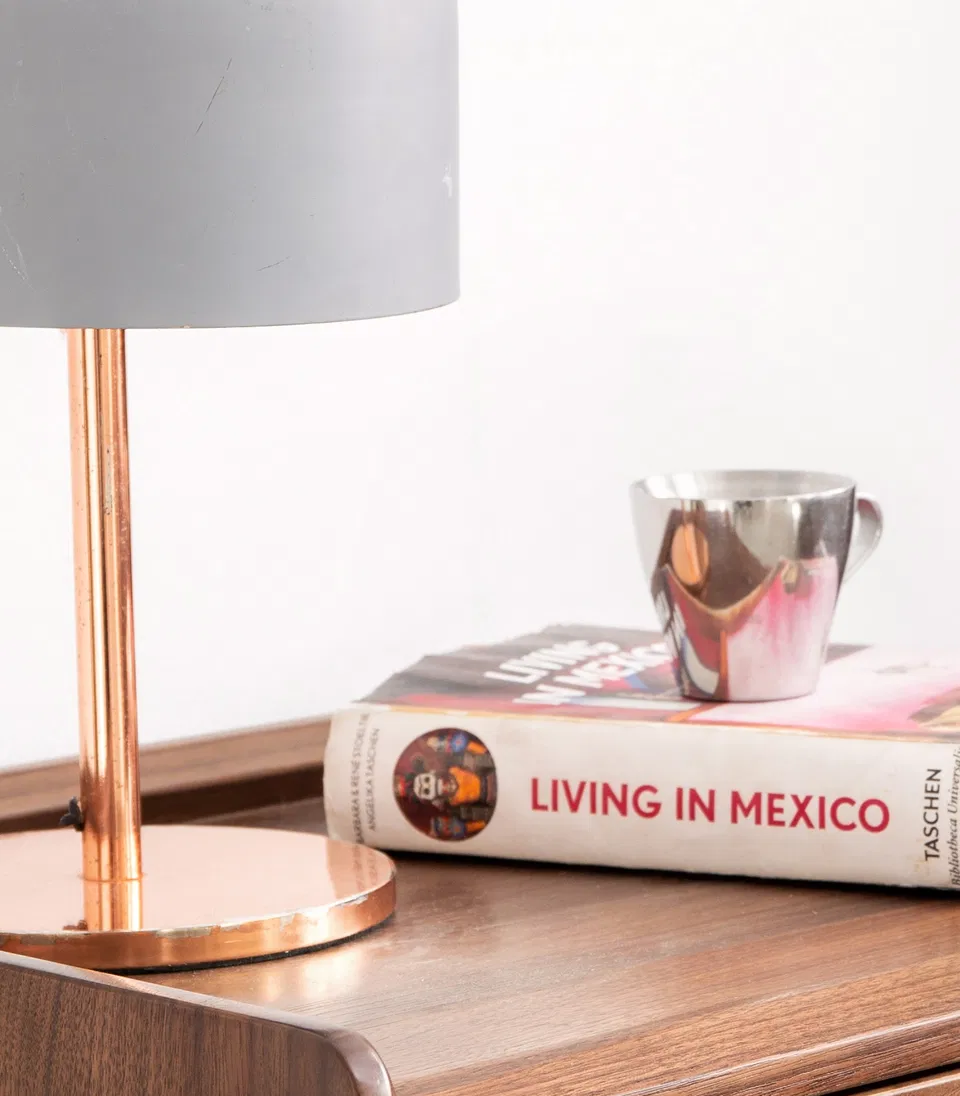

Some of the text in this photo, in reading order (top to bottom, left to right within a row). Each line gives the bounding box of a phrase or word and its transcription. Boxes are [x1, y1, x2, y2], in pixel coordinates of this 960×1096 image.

[365, 728, 380, 777] TASCHEN
[364, 779, 376, 831] ANGELIKA
[531, 778, 890, 833] LIVING IN MEXICO
[923, 768, 942, 861] TASCHEN
